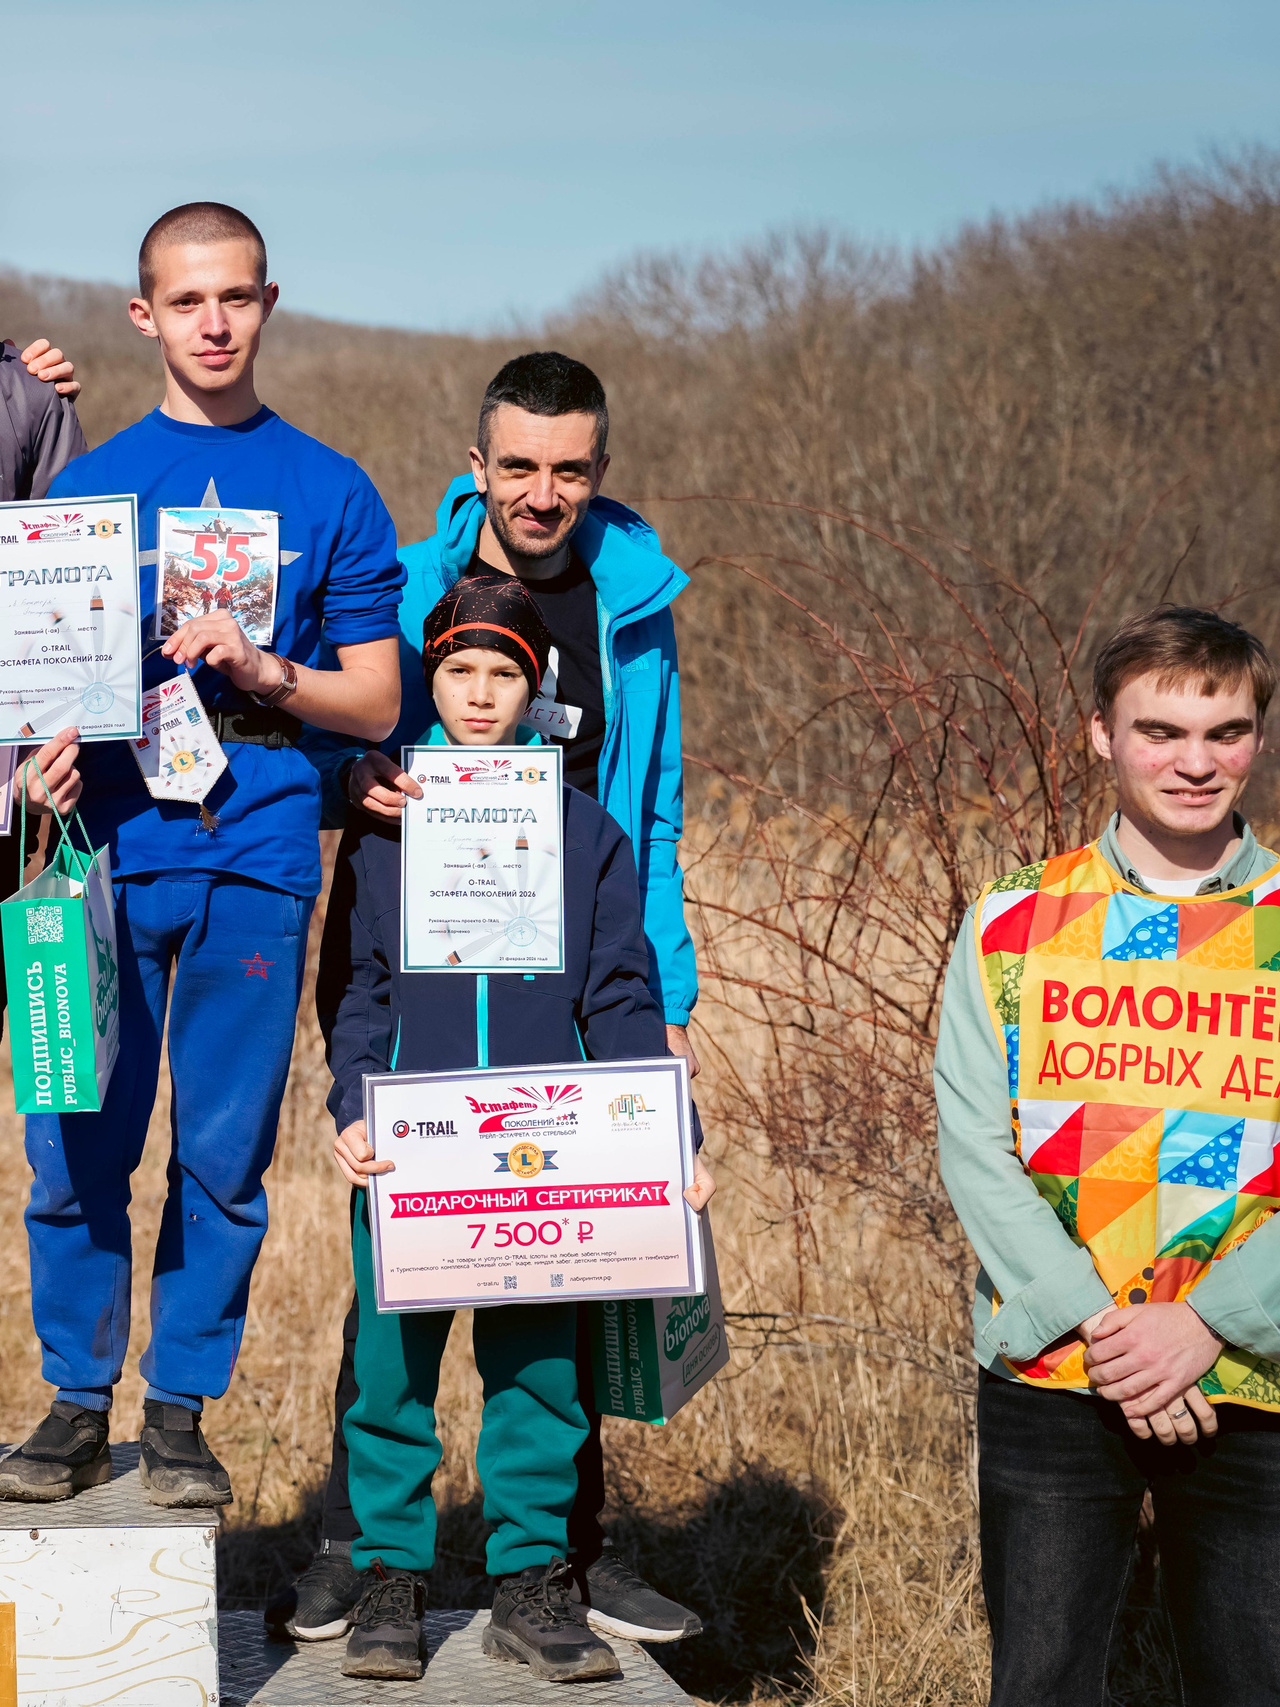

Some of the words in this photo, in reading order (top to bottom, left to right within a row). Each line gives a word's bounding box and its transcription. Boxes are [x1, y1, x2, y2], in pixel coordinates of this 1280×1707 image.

[190, 534, 251, 582] 55
[0, 657, 41, 667] ЭСТАФЕТА
[43, 654, 93, 665] ПОКОЛЕНИЙ
[94, 654, 113, 662] 2026
[41, 644, 71, 652] O-TRAIL
[426, 807, 538, 824] ГРАМОТА
[470, 889, 517, 897] ПОКОЛЕНИЙ
[1042, 979, 1280, 1042] ВОЛОНТЁ
[26, 960, 52, 1107] ПОДПИШИСЬ
[54, 963, 77, 1105] PUBLIC_BIONOVA
[1038, 1039, 1204, 1089] ДОБРЫХ
[464, 1094, 538, 1114] Эстафета
[479, 1131, 530, 1139] ТРЕЙЛ-ЭСТАФЕТА
[543, 1129, 577, 1137] СТРЕЛЬБОЙ
[504, 1118, 555, 1128] ПОКОЛЕНИЙ
[521, 1153, 532, 1166] L
[398, 1190, 528, 1214] ПОДАРОЧНЫЙ
[536, 1185, 663, 1206] СЕРТИФИКАТ
[466, 1223, 487, 1249] 7
[665, 1296, 710, 1352] bionova
[603, 1301, 625, 1412] ПОДПИШИС
[685, 1357, 698, 1379] ДНЯ
[698, 1331, 719, 1363] ОСНОВА
